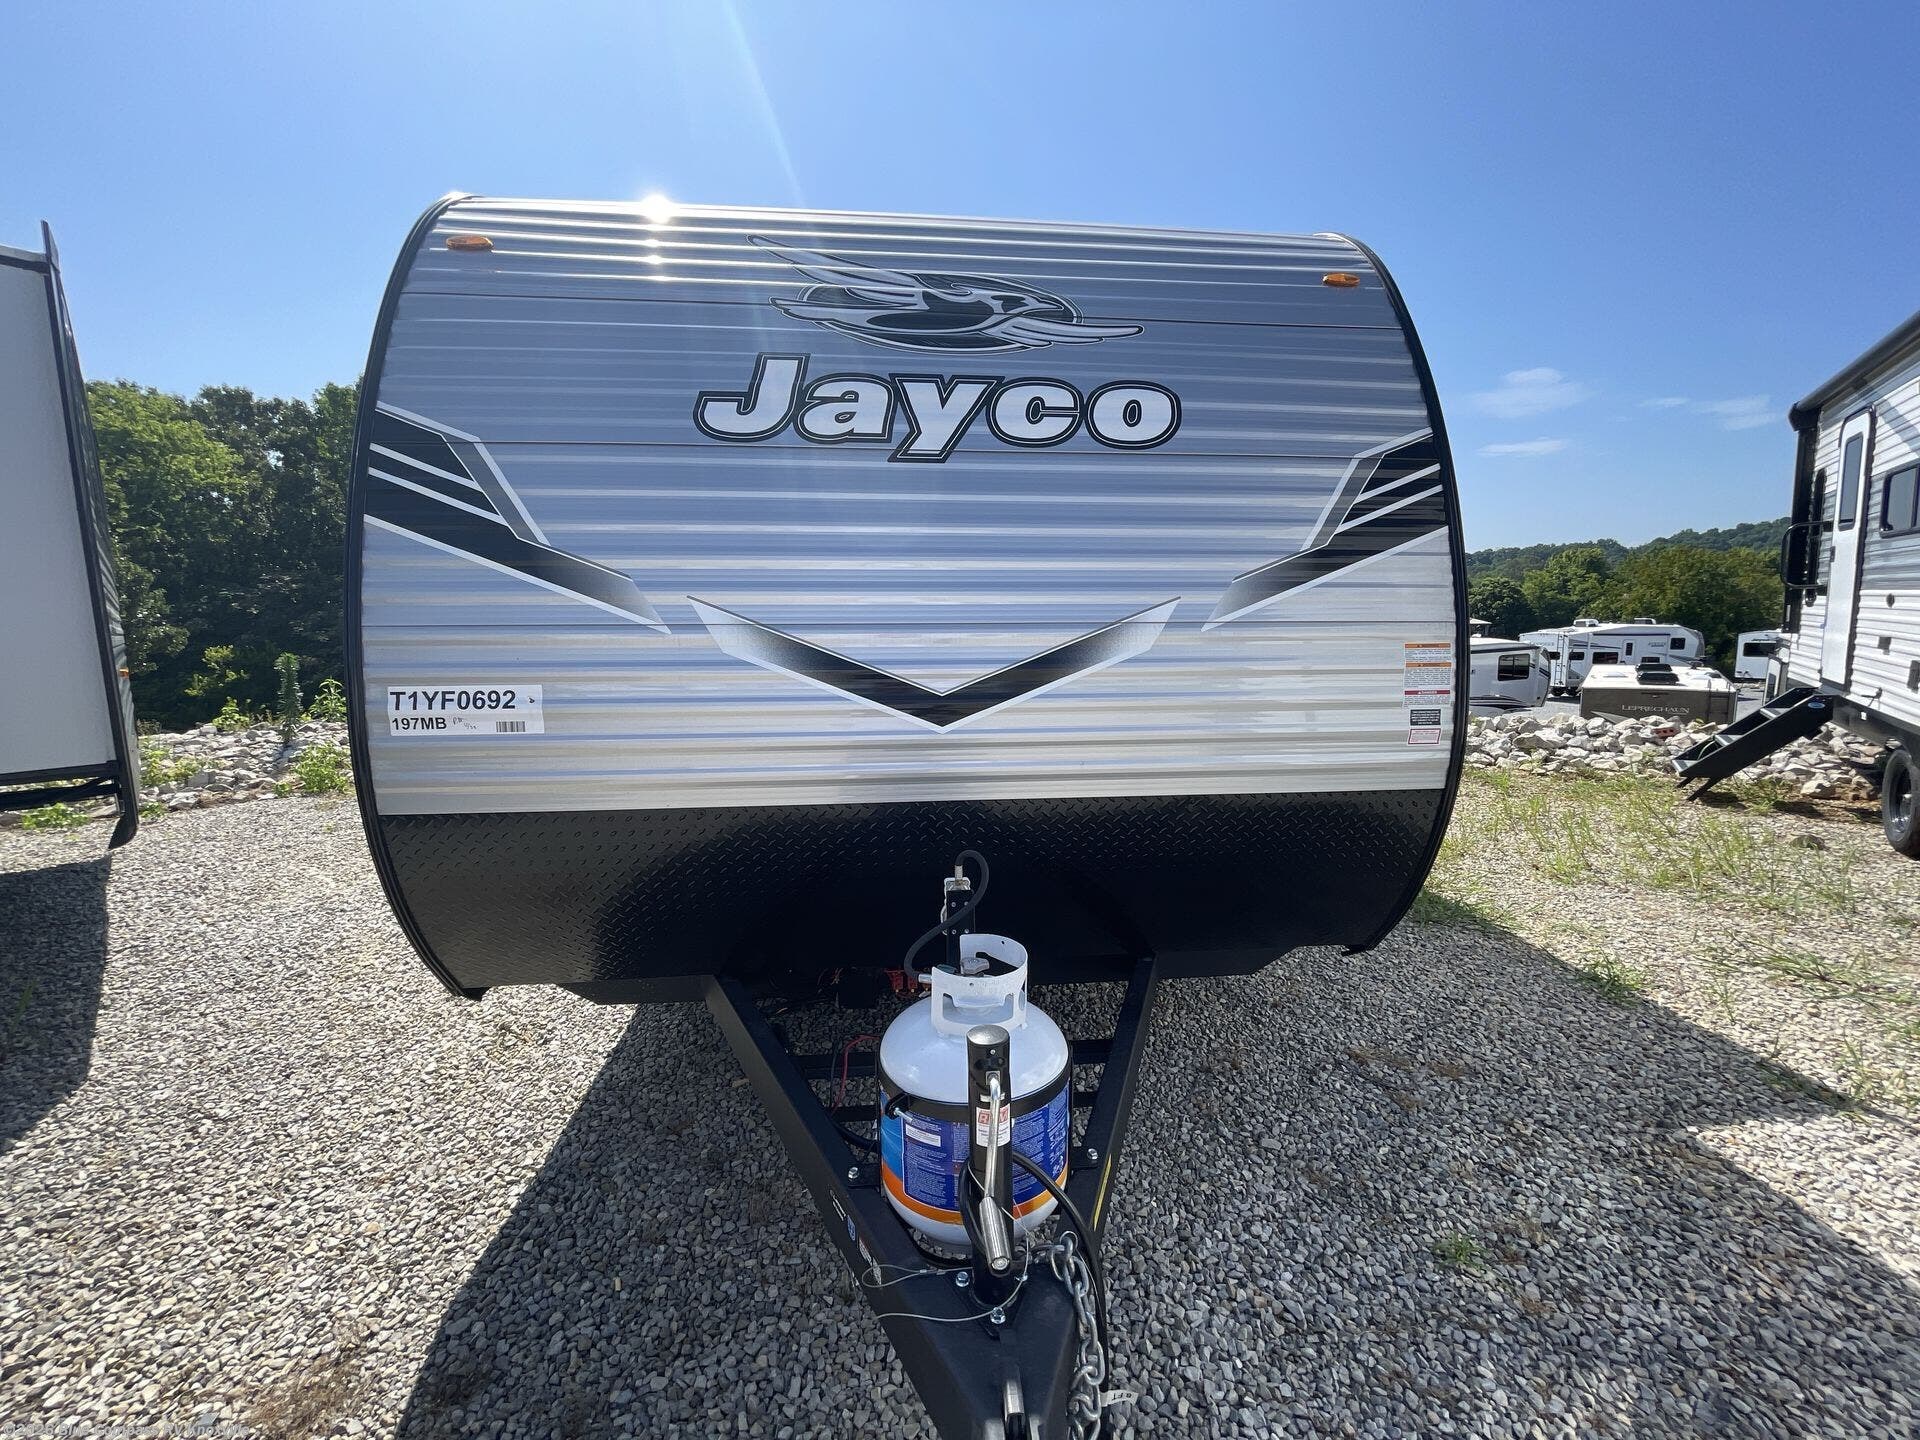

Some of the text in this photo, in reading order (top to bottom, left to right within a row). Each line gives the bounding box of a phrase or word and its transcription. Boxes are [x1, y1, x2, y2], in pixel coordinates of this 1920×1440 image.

[692, 352, 1183, 464] Jayco
[389, 690, 516, 711] T1YF0692
[1621, 704, 1690, 714] LEPRECHAUN
[391, 717, 447, 730] 197MB
